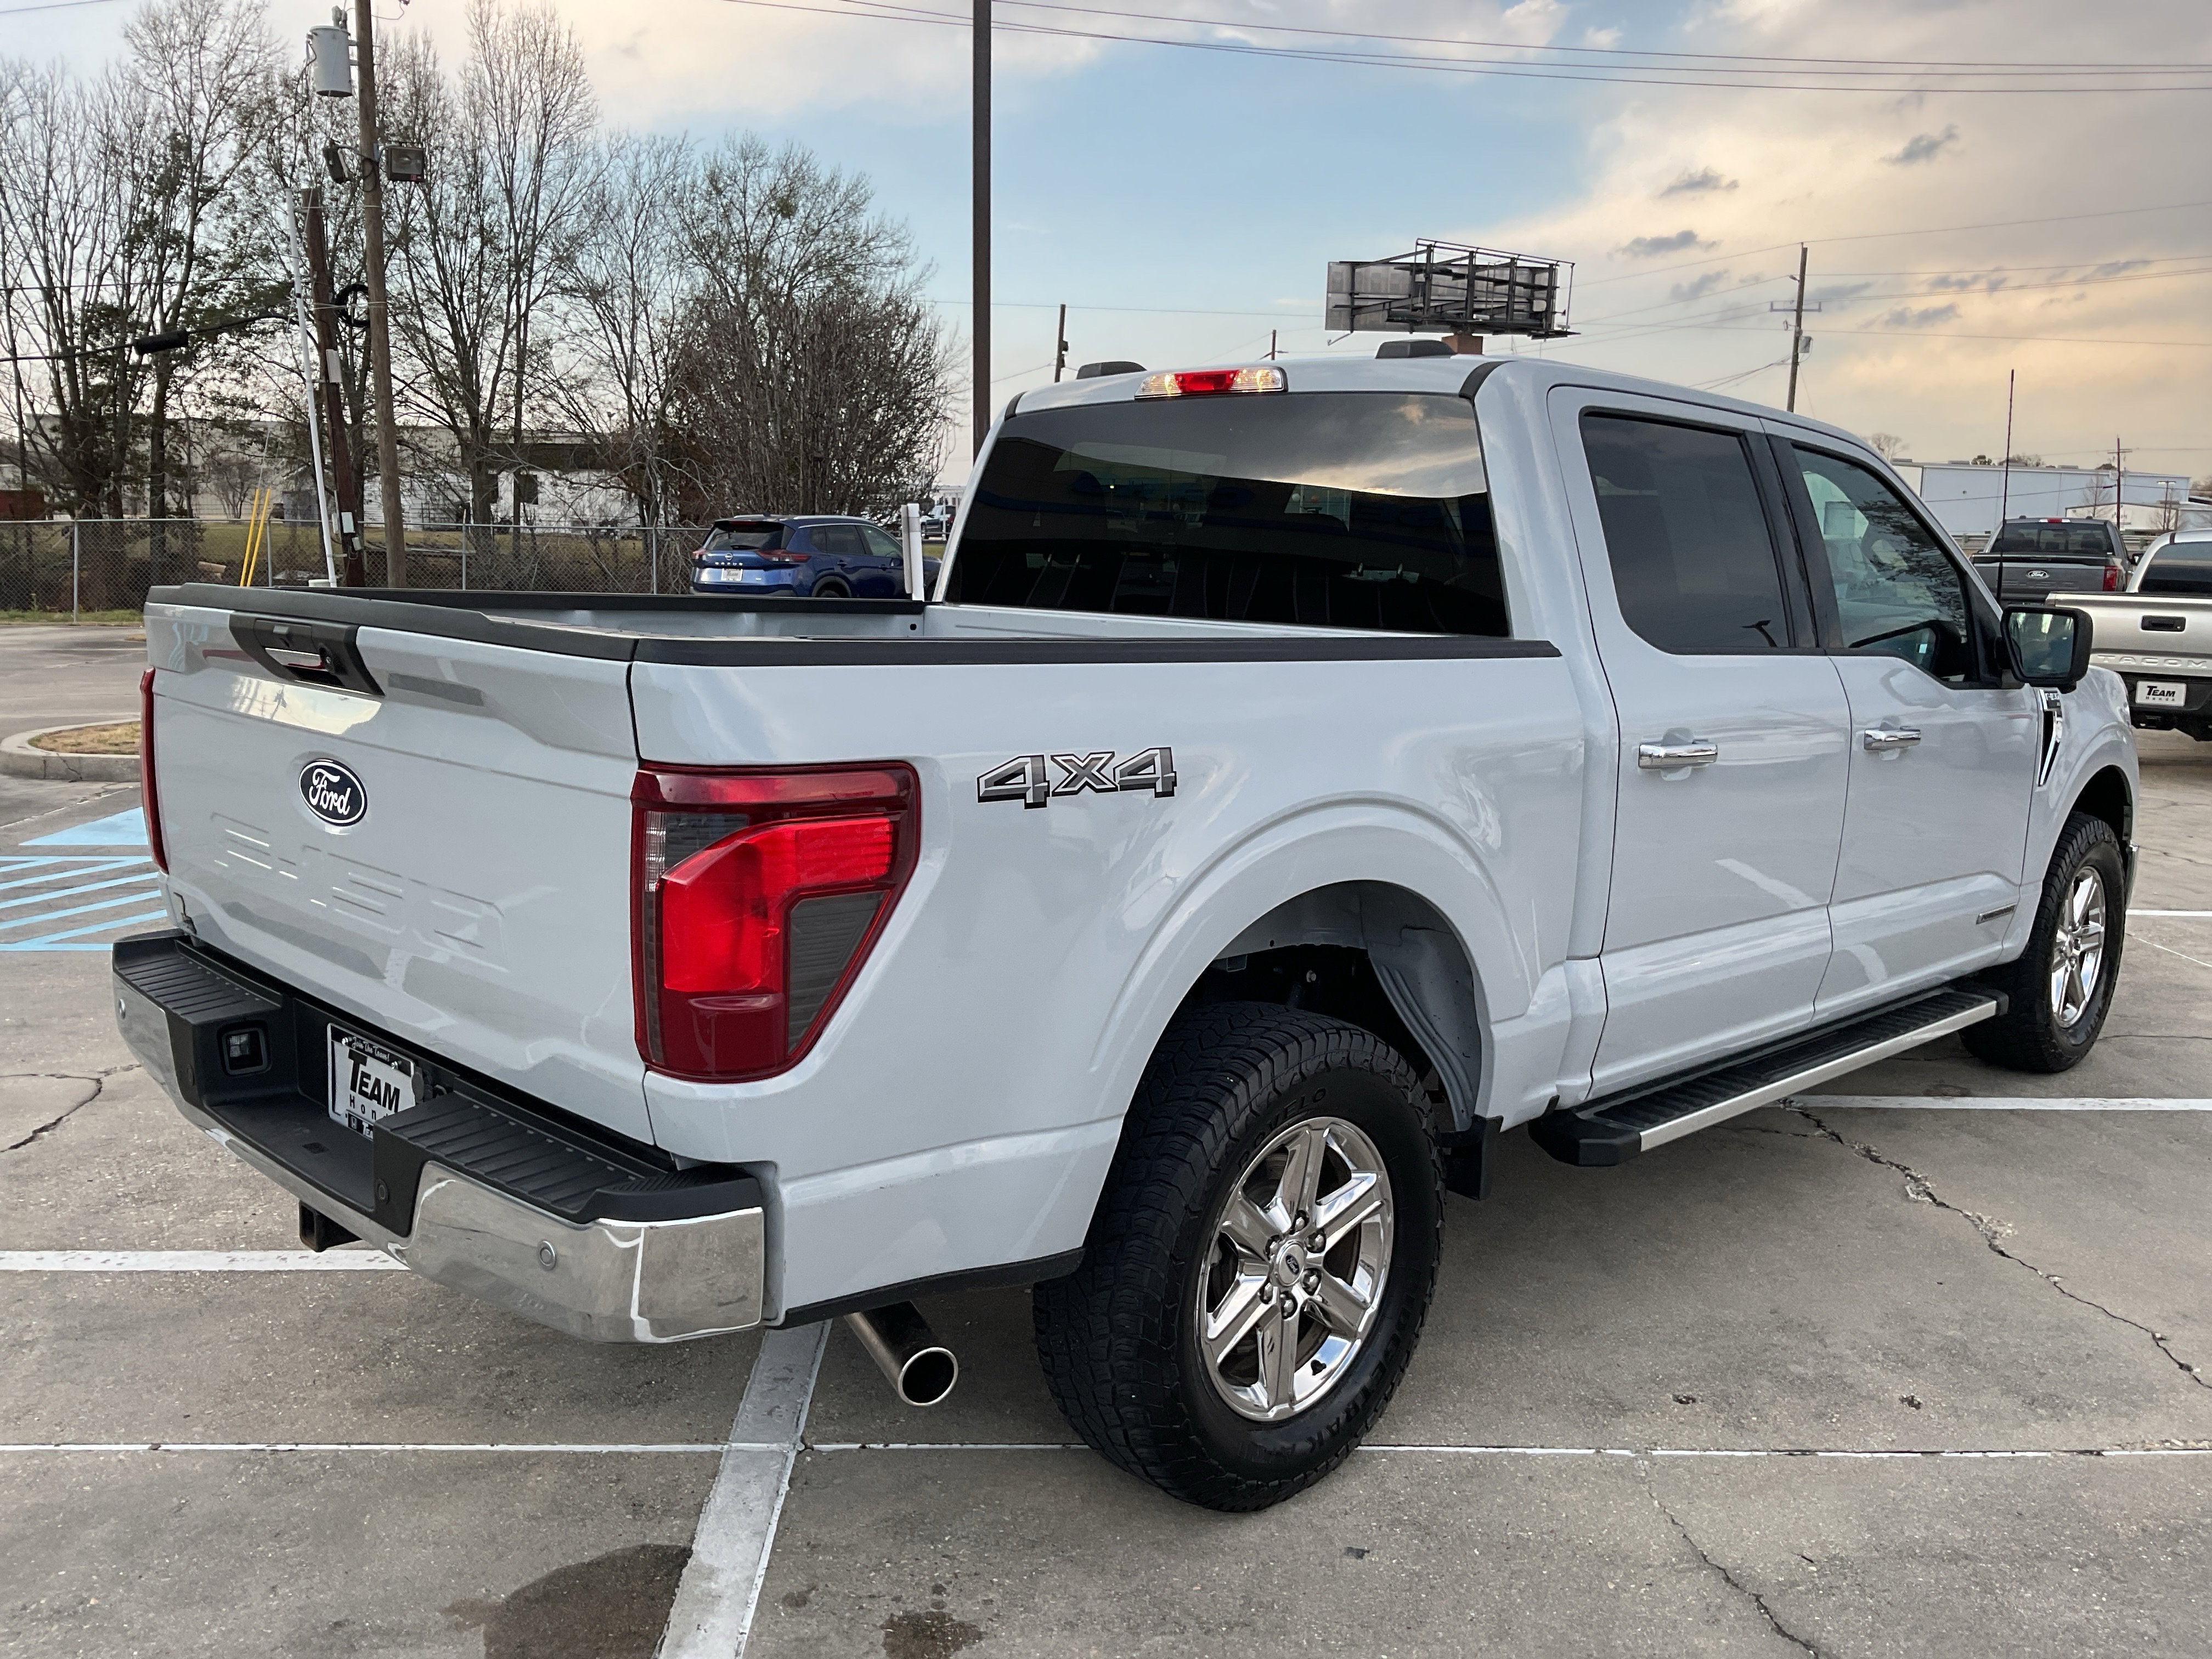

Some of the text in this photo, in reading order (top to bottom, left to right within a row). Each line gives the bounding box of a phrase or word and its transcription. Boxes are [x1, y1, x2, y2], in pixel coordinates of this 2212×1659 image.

[2147, 685, 2176, 697] TEAM
[309, 768, 351, 815] Ford
[363, 1041, 374, 1053] The
[348, 1048, 400, 1113] TEAM
[349, 1093, 388, 1120] Hon
[1287, 1257, 1298, 1273] Ford
[1307, 1268, 1422, 1453] IDGETRAK
